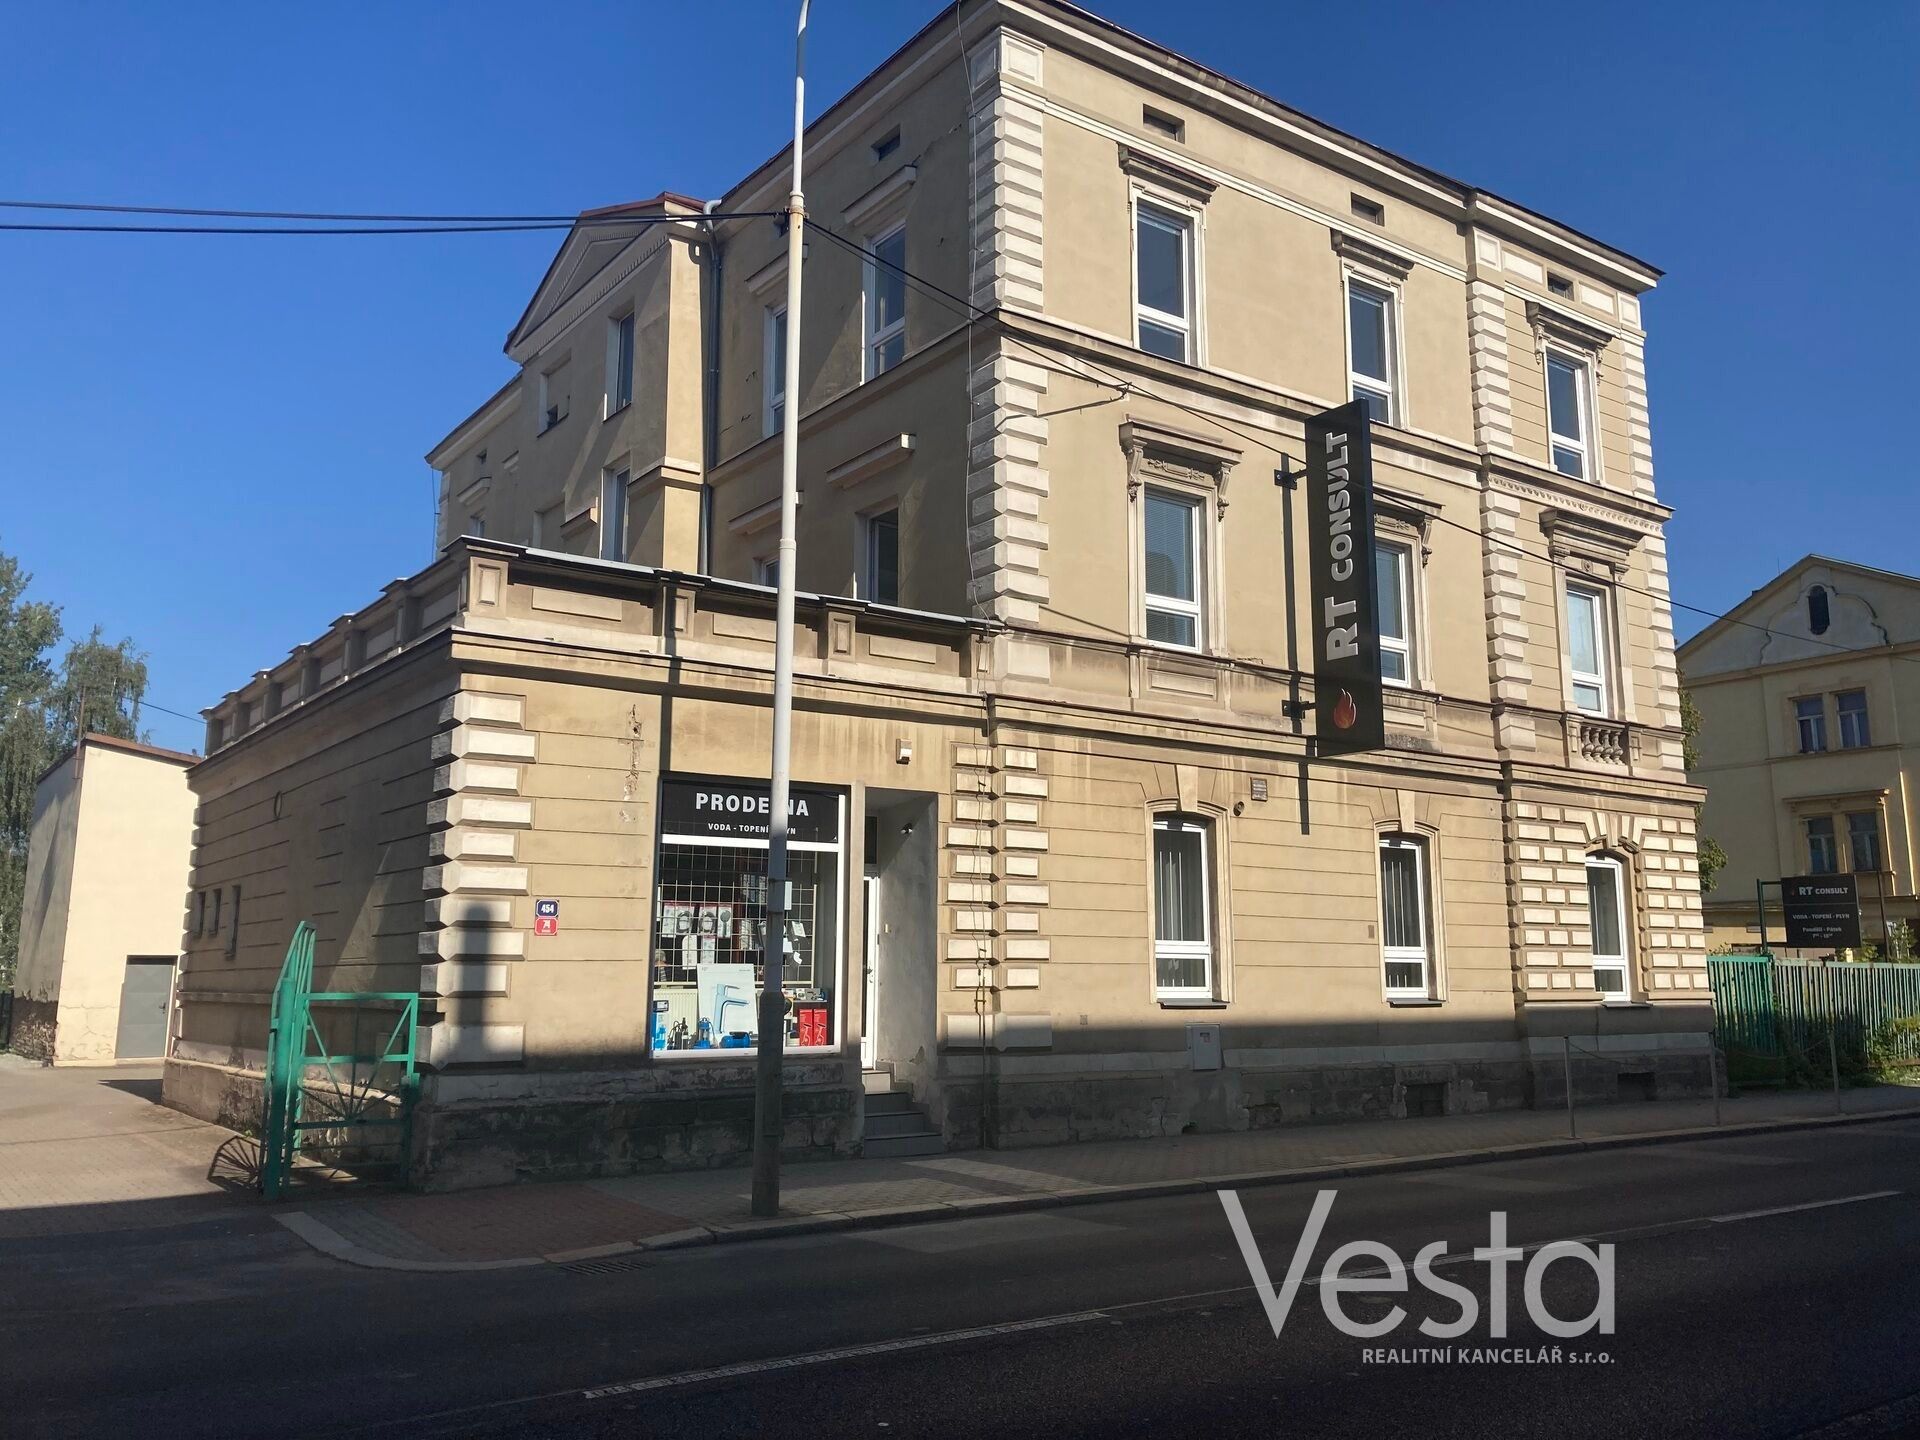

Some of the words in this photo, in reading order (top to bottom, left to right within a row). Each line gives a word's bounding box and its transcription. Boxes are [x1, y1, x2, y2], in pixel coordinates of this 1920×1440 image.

[1325, 431, 1354, 582] CONSULT
[1324, 596, 1359, 662] RT
[695, 792, 810, 817] PRODENA
[708, 823, 731, 832] VODA
[738, 824, 769, 834] TOPENÍ
[1798, 886, 1813, 895] RT
[541, 904, 555, 913] 454
